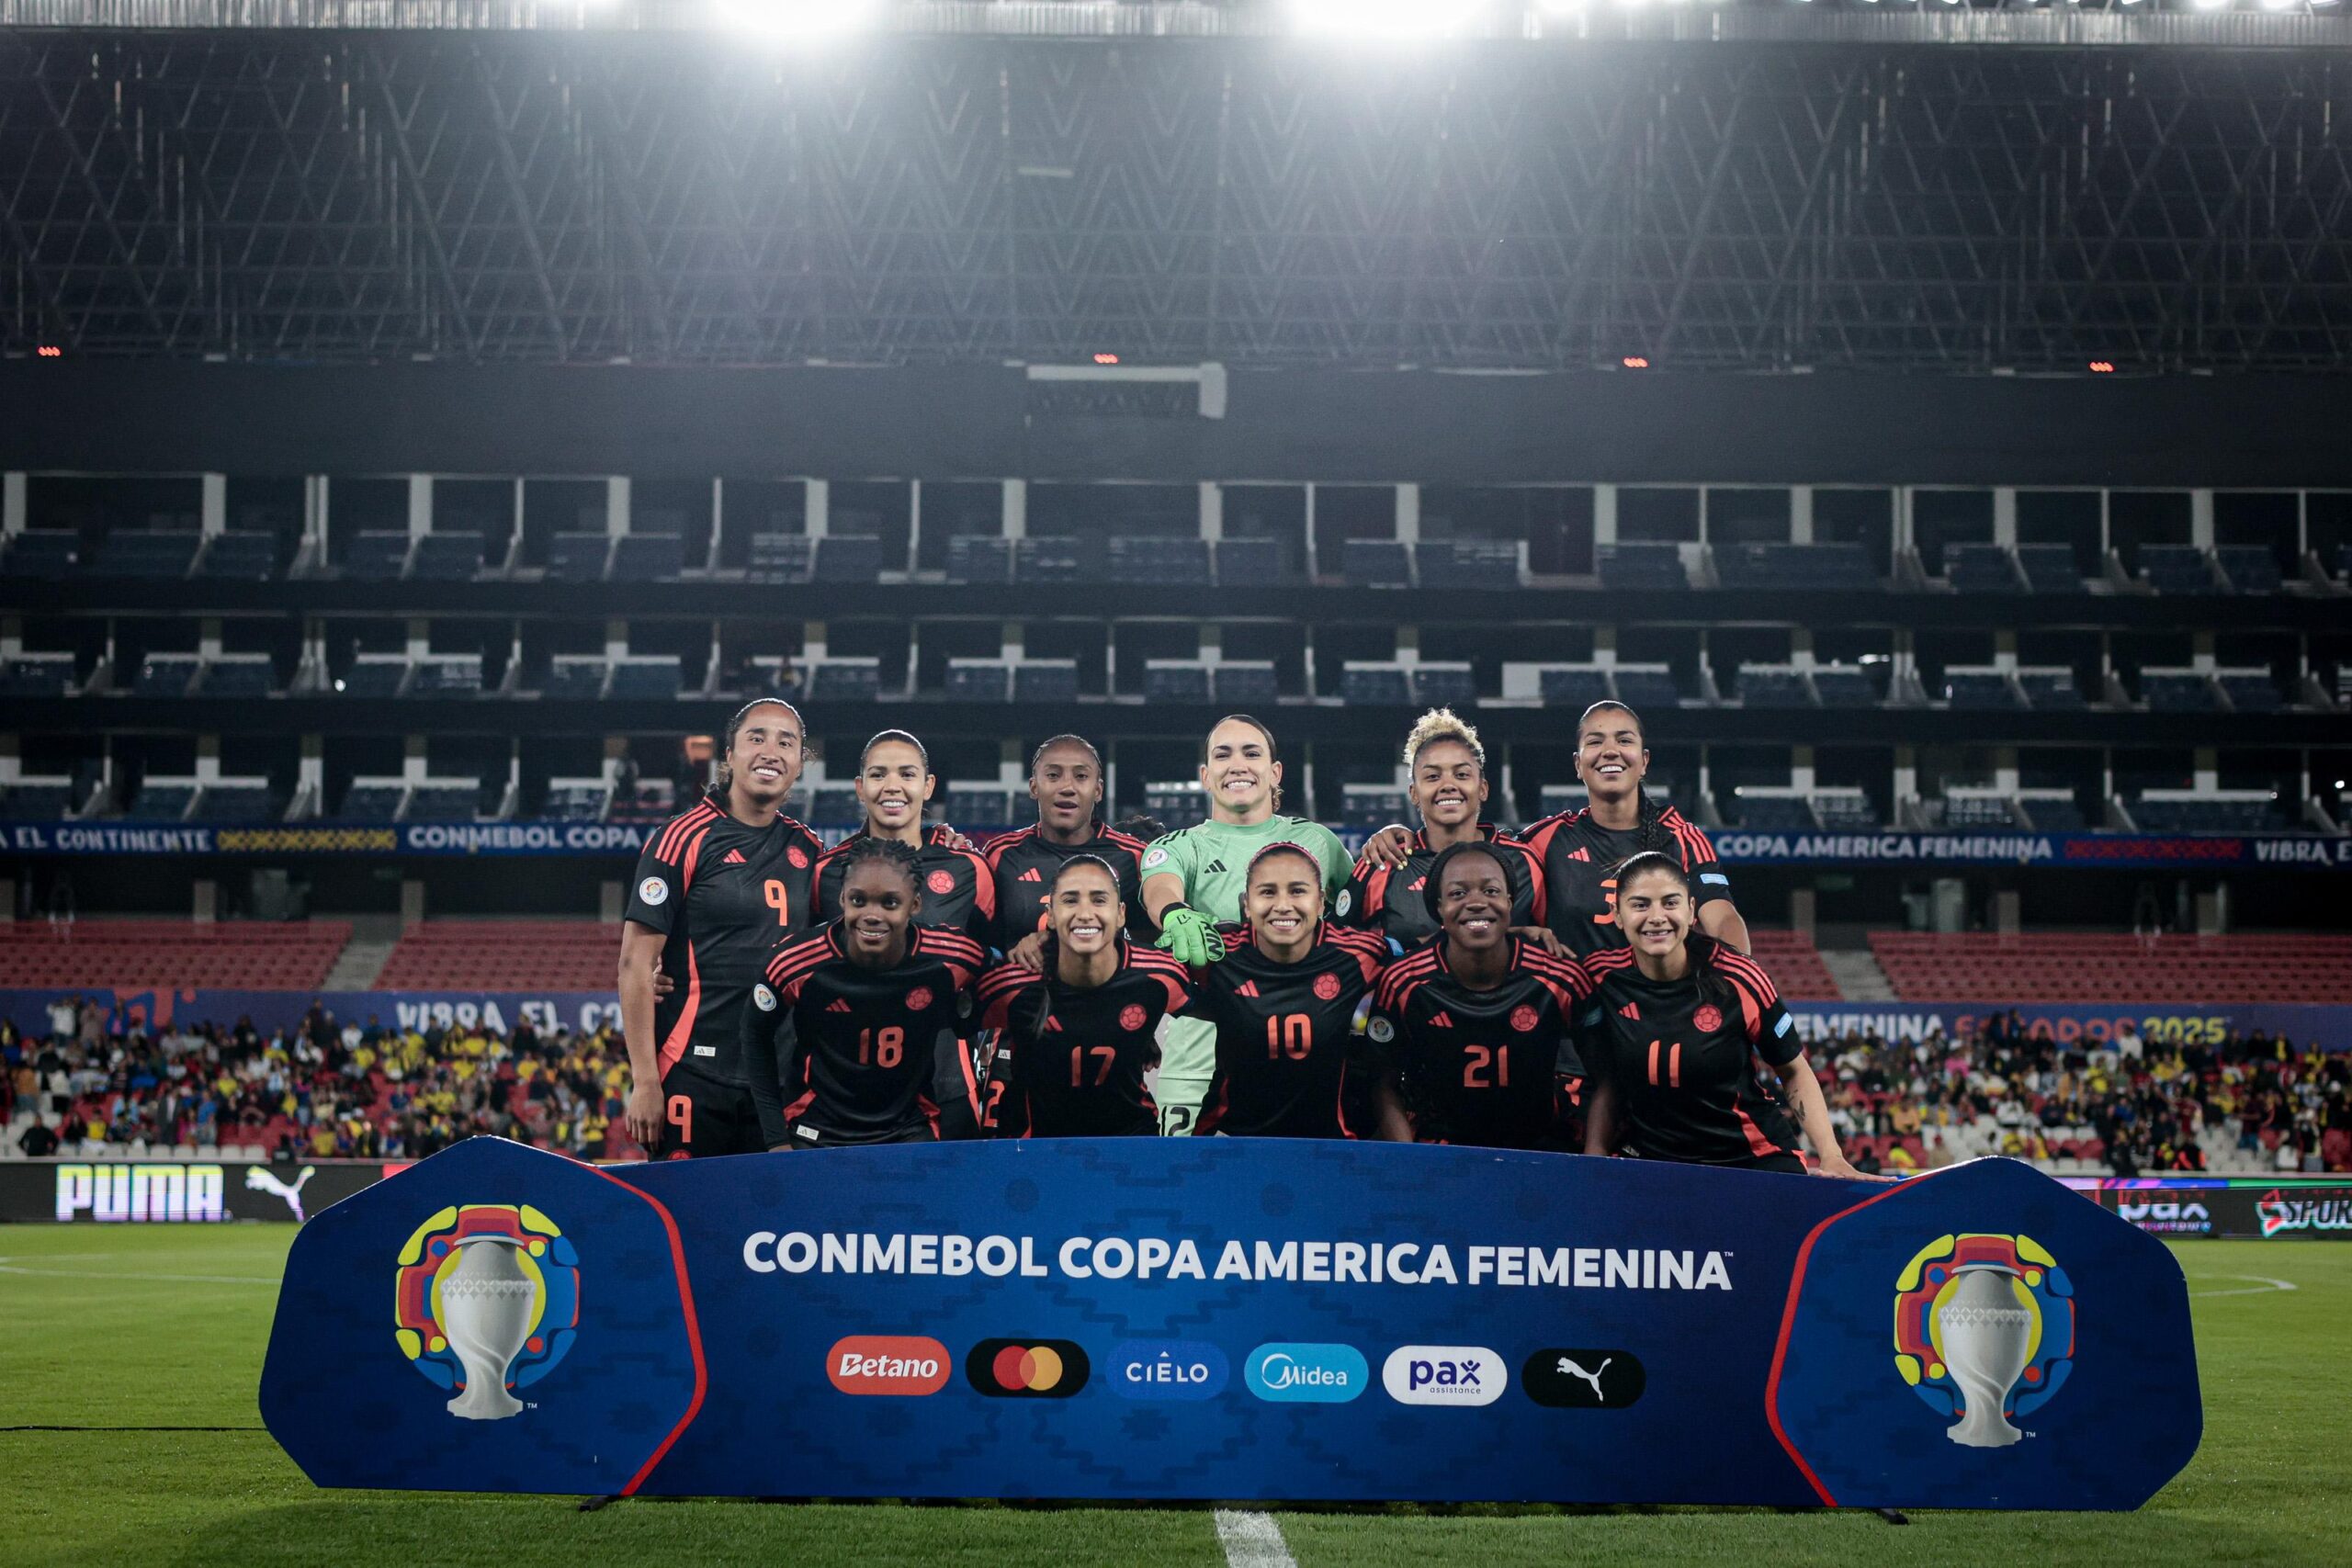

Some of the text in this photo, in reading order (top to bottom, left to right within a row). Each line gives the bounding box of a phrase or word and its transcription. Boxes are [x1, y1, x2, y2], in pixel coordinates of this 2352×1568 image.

[16, 827, 47, 849] EL
[56, 829, 210, 852] CONTINENTE
[409, 827, 562, 848] CONMEBOL
[566, 827, 641, 849] COPA
[1716, 835, 2052, 860] COPA AMERICA FEMENINA
[2256, 840, 2328, 862] VIBRA
[764, 879, 787, 927] 9
[396, 1000, 507, 1036] VIBRA
[1267, 1013, 1312, 1060] 10
[1792, 1013, 1947, 1043] EMENINA
[2143, 1016, 2226, 1045] 2025
[859, 1026, 904, 1068] 18
[1071, 1045, 1116, 1088] 17
[1464, 1044, 1509, 1088] 21
[1647, 1040, 1680, 1089] 11
[667, 1095, 691, 1144] 9
[983, 1080, 1005, 1128] 2
[56, 1165, 223, 1222] PUMA
[742, 1231, 1048, 1277] CONMEBOL
[1058, 1236, 1206, 1280] COPA
[1213, 1240, 1458, 1284] AMERICA
[1468, 1246, 1733, 1291] FEMENINA
[839, 1353, 938, 1378] Betano
[1261, 1353, 1347, 1390] Midea
[1409, 1359, 1481, 1391] pax
[1430, 1386, 1481, 1394] assistance
